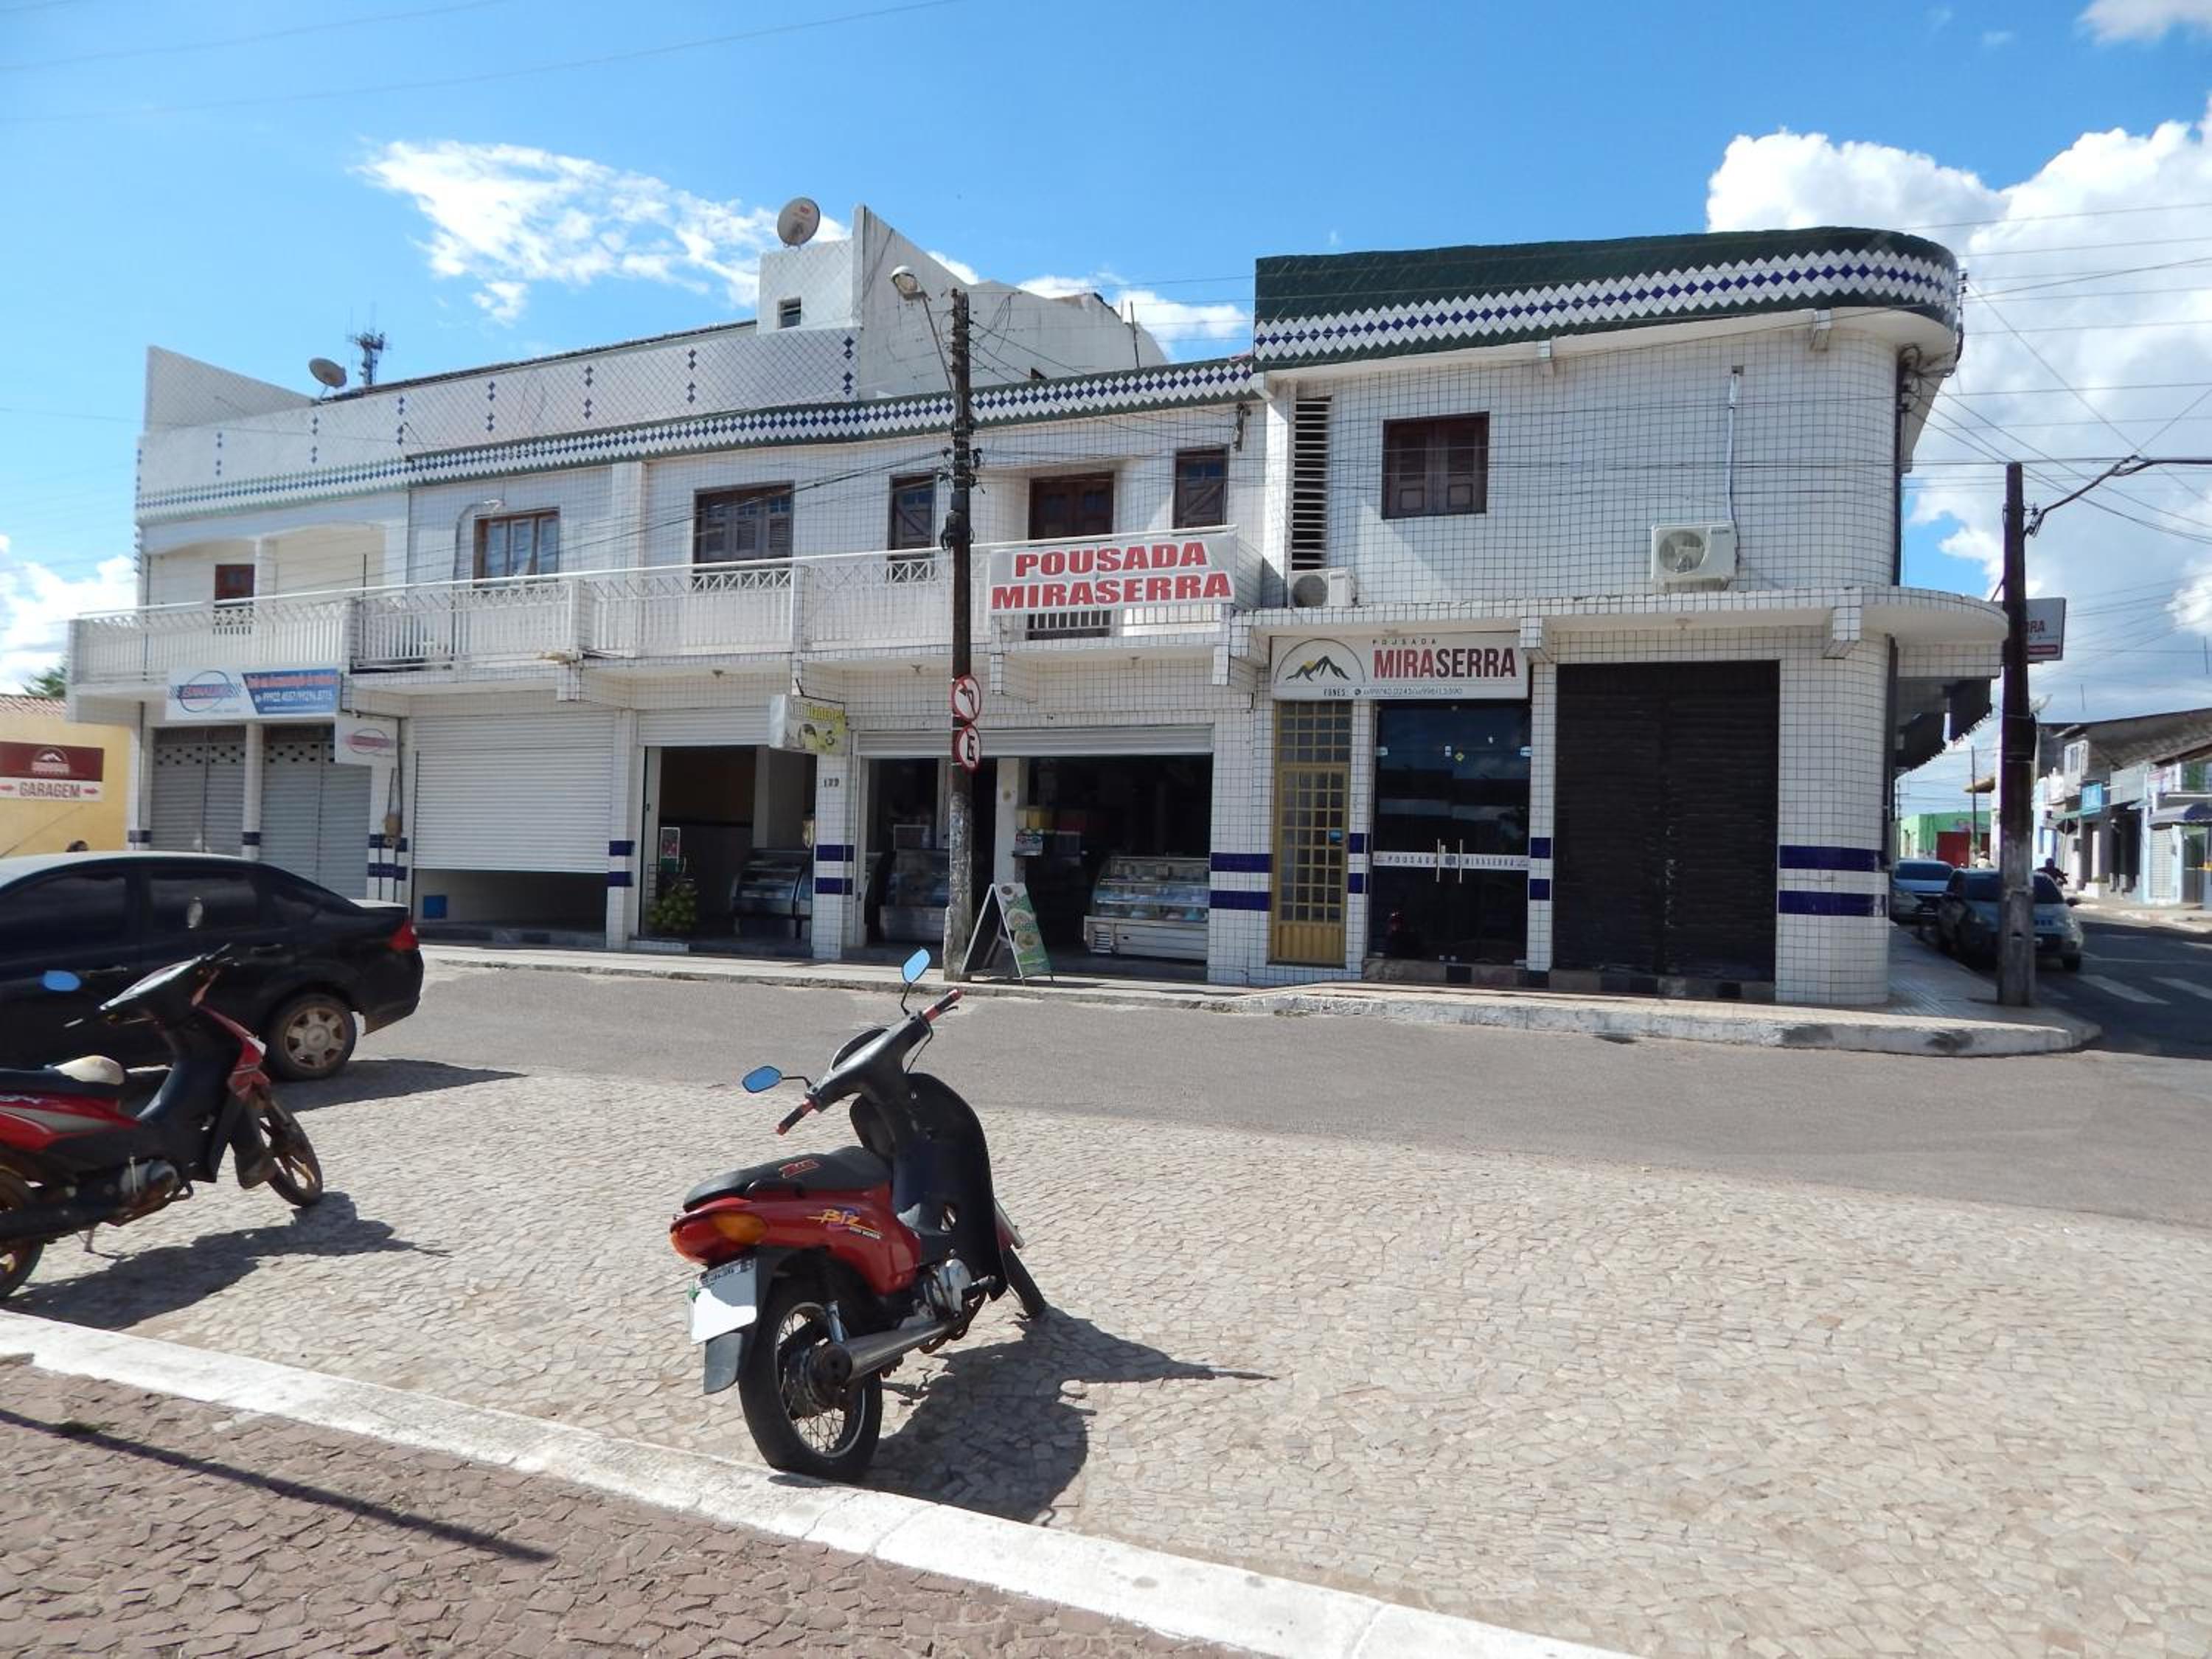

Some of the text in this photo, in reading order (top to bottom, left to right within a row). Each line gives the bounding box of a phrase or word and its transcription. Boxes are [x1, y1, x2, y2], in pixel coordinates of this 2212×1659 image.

[1015, 542, 1208, 578] POUSADA
[991, 572, 1232, 610] MIRASERRA
[1374, 647, 1517, 678] MIRASERRA
[19, 782, 80, 799] GARAGEM
